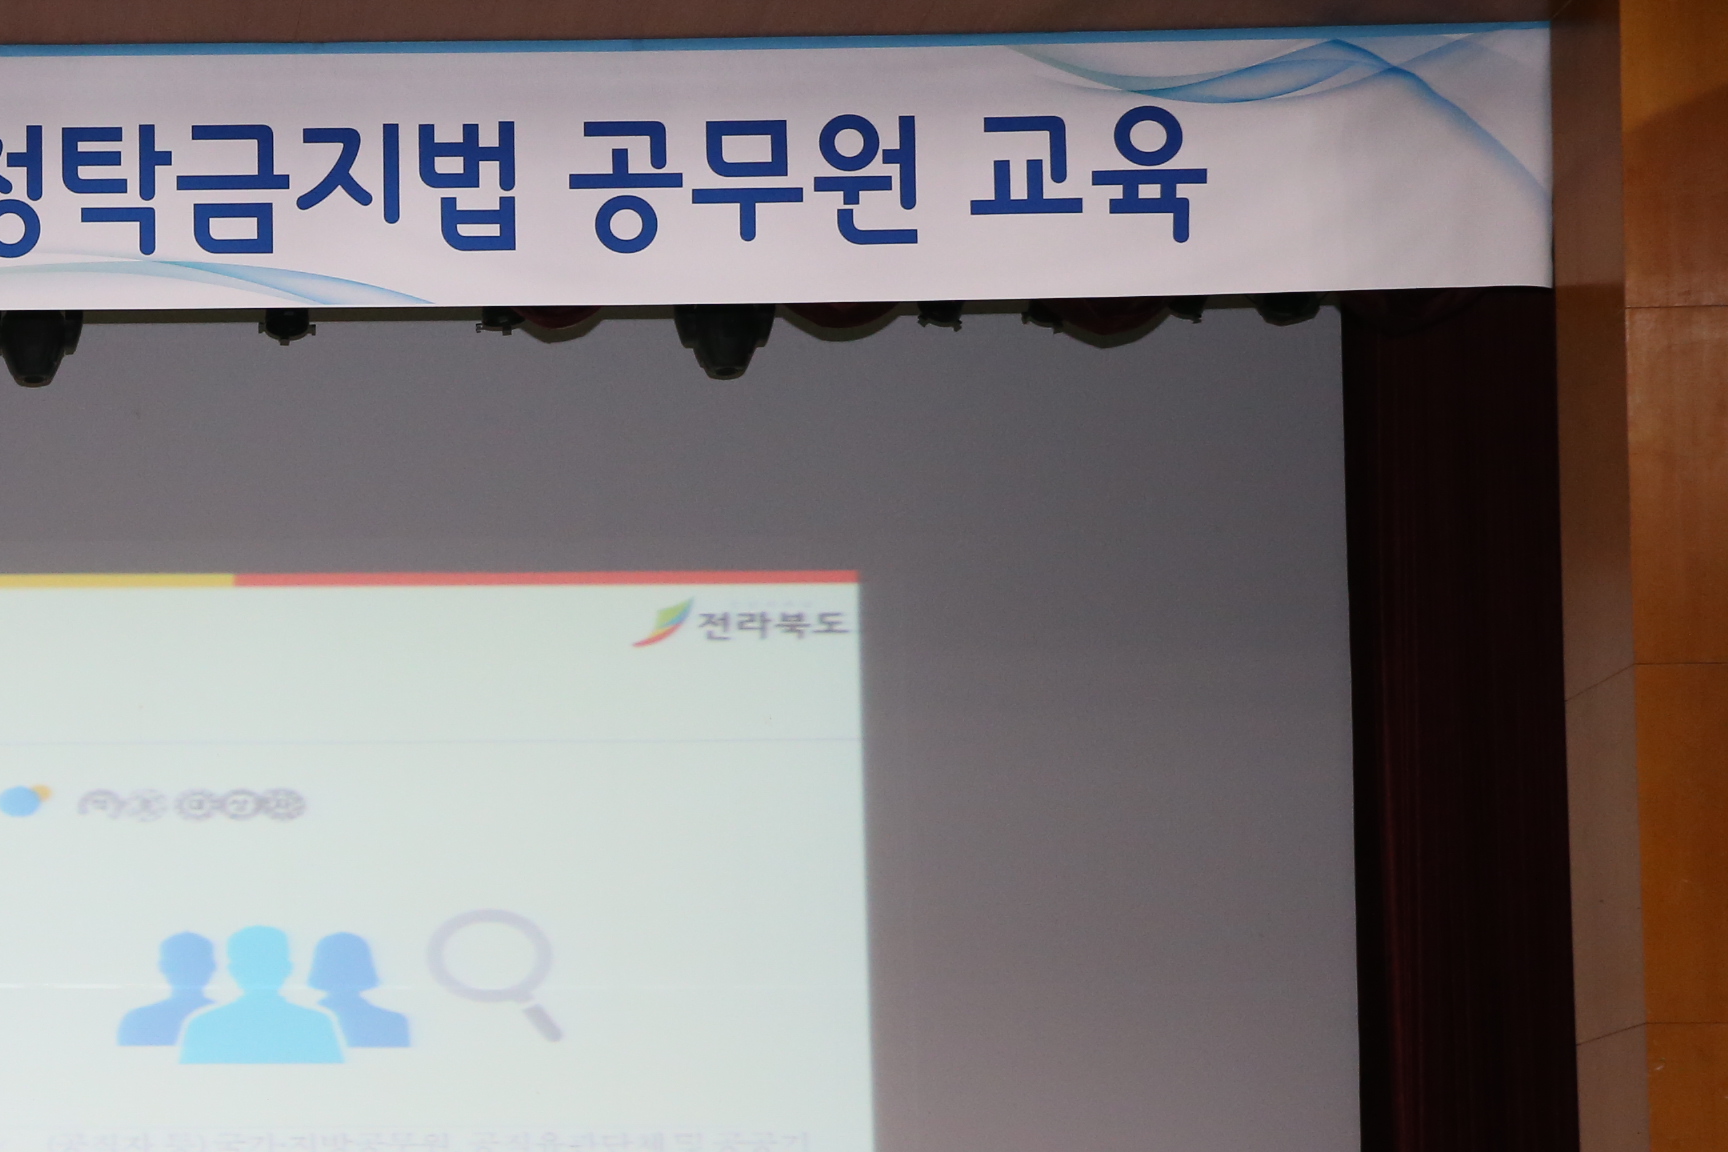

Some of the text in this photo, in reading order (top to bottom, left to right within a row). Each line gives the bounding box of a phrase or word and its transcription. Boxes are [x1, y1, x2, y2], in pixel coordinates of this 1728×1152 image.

[569, 114, 918, 253] 공무원
[970, 105, 1208, 243] 교육
[699, 610, 851, 641] 전라북도
